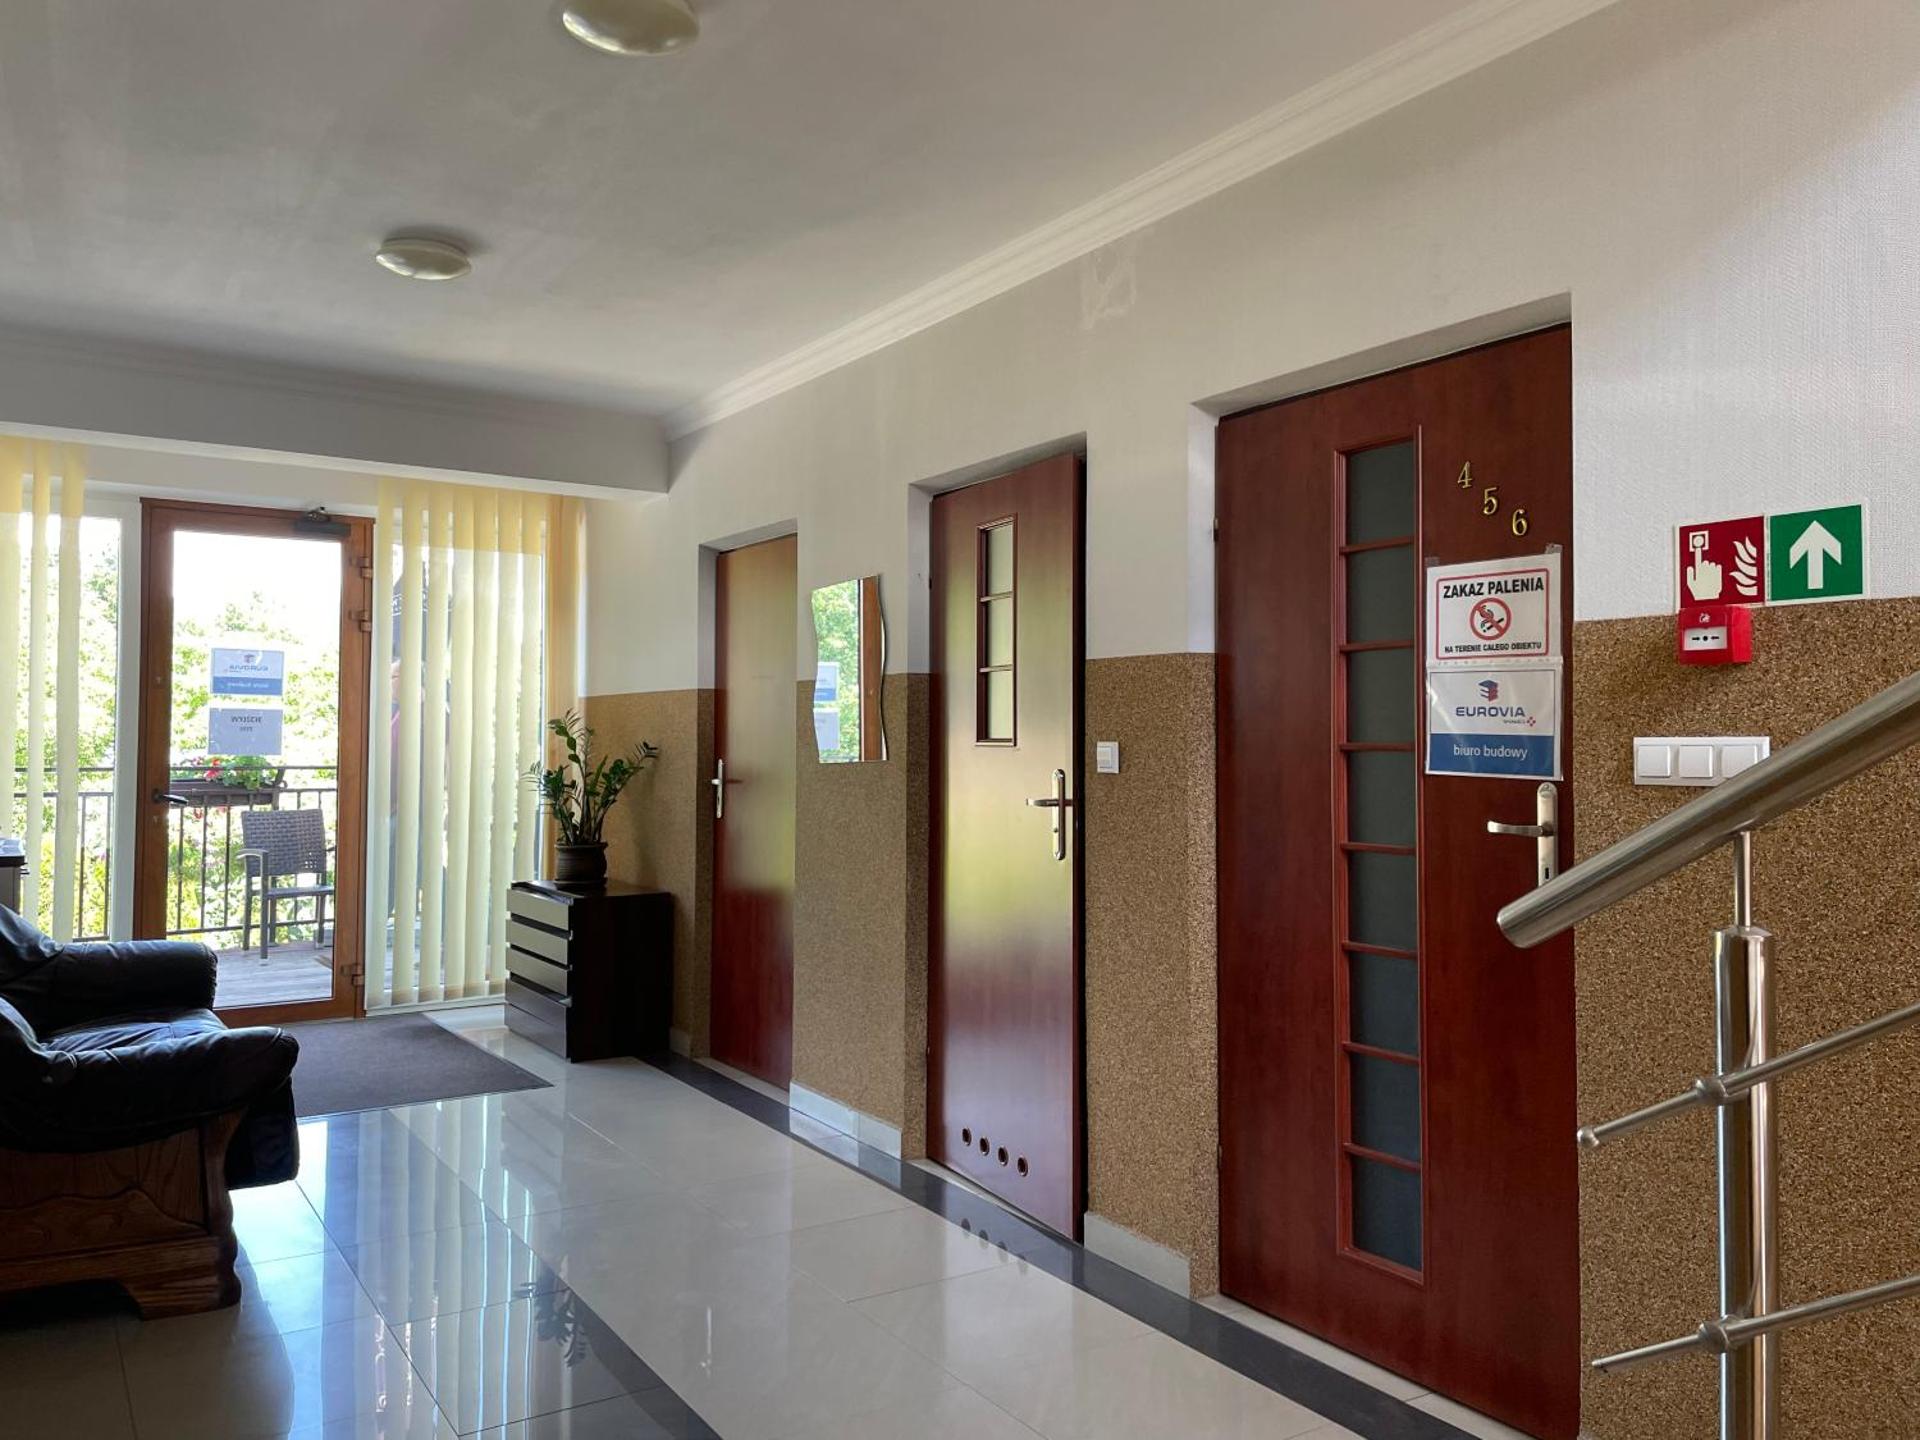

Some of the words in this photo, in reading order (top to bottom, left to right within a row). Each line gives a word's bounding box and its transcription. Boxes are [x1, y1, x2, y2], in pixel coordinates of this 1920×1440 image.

[1457, 460, 1473, 489] 4
[1483, 487, 1498, 515] 5
[1512, 508, 1528, 536] 6
[1443, 582, 1484, 599] ZAKAZ
[1488, 577, 1544, 595] PALENIA
[1444, 645, 1454, 654] NA
[1455, 644, 1481, 653] TERENIE
[1511, 641, 1542, 650] OBIEKTU
[1455, 706, 1526, 718] EUROVIA
[1453, 743, 1481, 757] biuro
[1483, 744, 1528, 761] budowy
